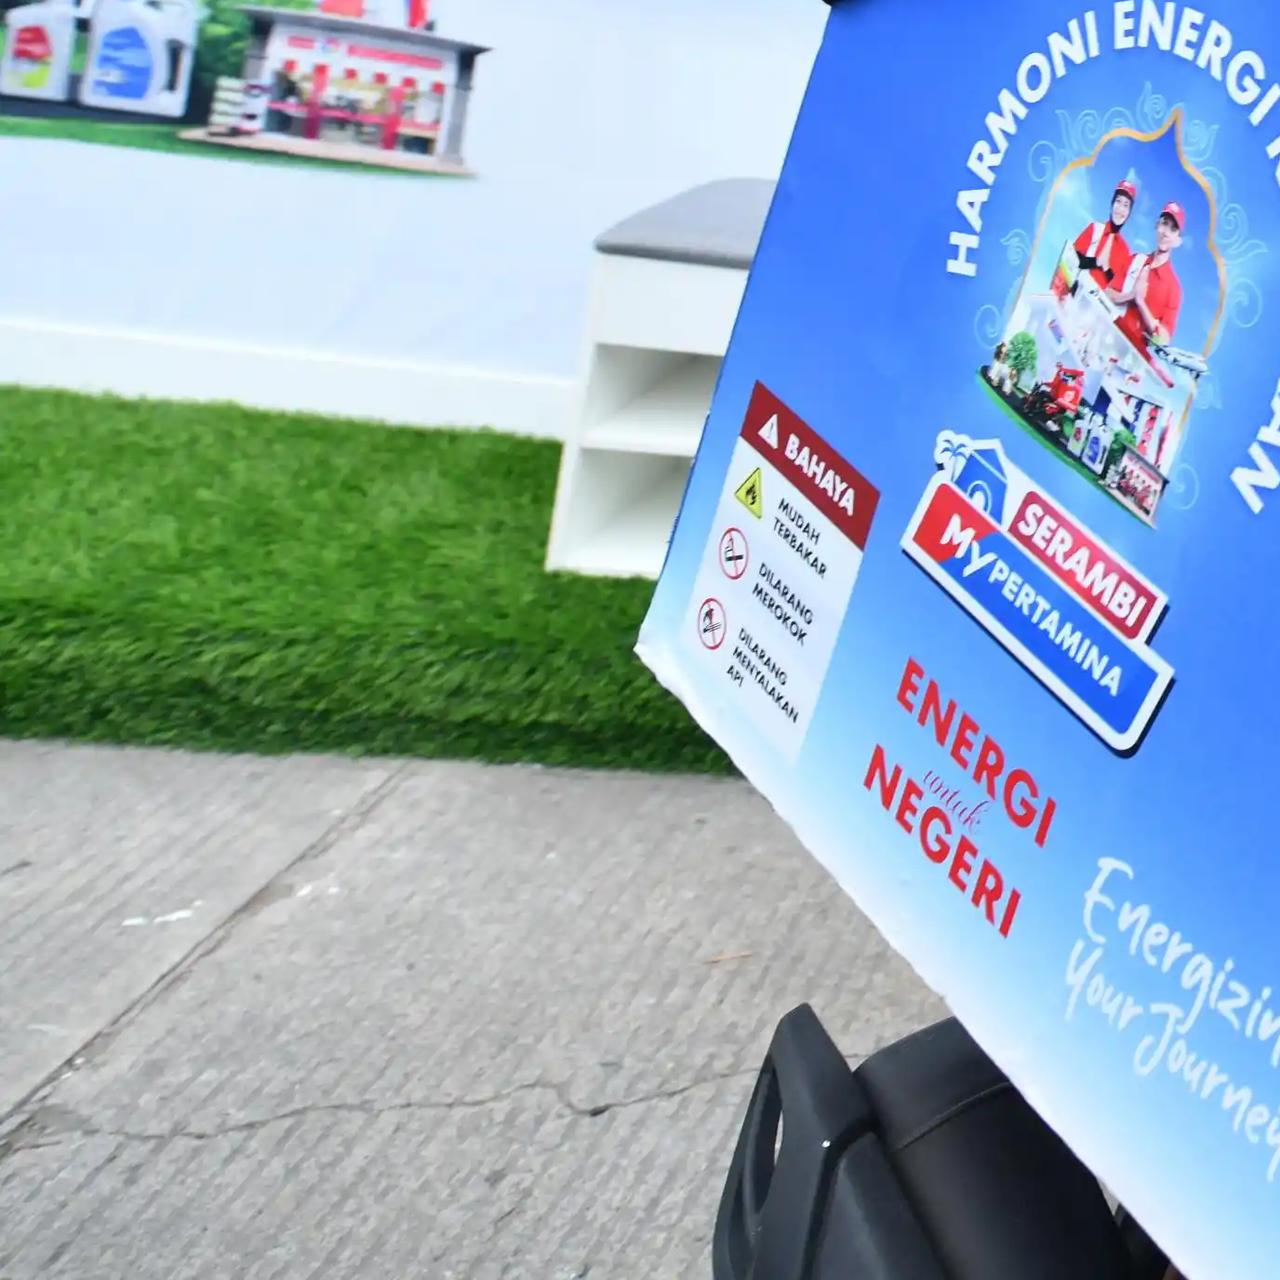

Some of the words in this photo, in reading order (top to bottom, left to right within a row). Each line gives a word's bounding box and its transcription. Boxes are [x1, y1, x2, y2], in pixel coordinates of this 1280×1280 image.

[946, 10, 1100, 277] HARMONI
[784, 433, 855, 516] BAHAYA
[773, 516, 827, 579] TERBAKAR
[778, 498, 821, 545] MUDAH
[758, 562, 814, 625] DILARANG
[1018, 503, 1148, 628] SERAMBI
[752, 583, 809, 647] MEROKOK
[726, 665, 744, 688] API
[731, 646, 799, 724] MENYALAKAN
[738, 627, 788, 686] DILARANG
[896, 657, 1058, 848] ENERGI
[922, 769, 997, 833] untuk
[863, 744, 1022, 939] NEGERI
